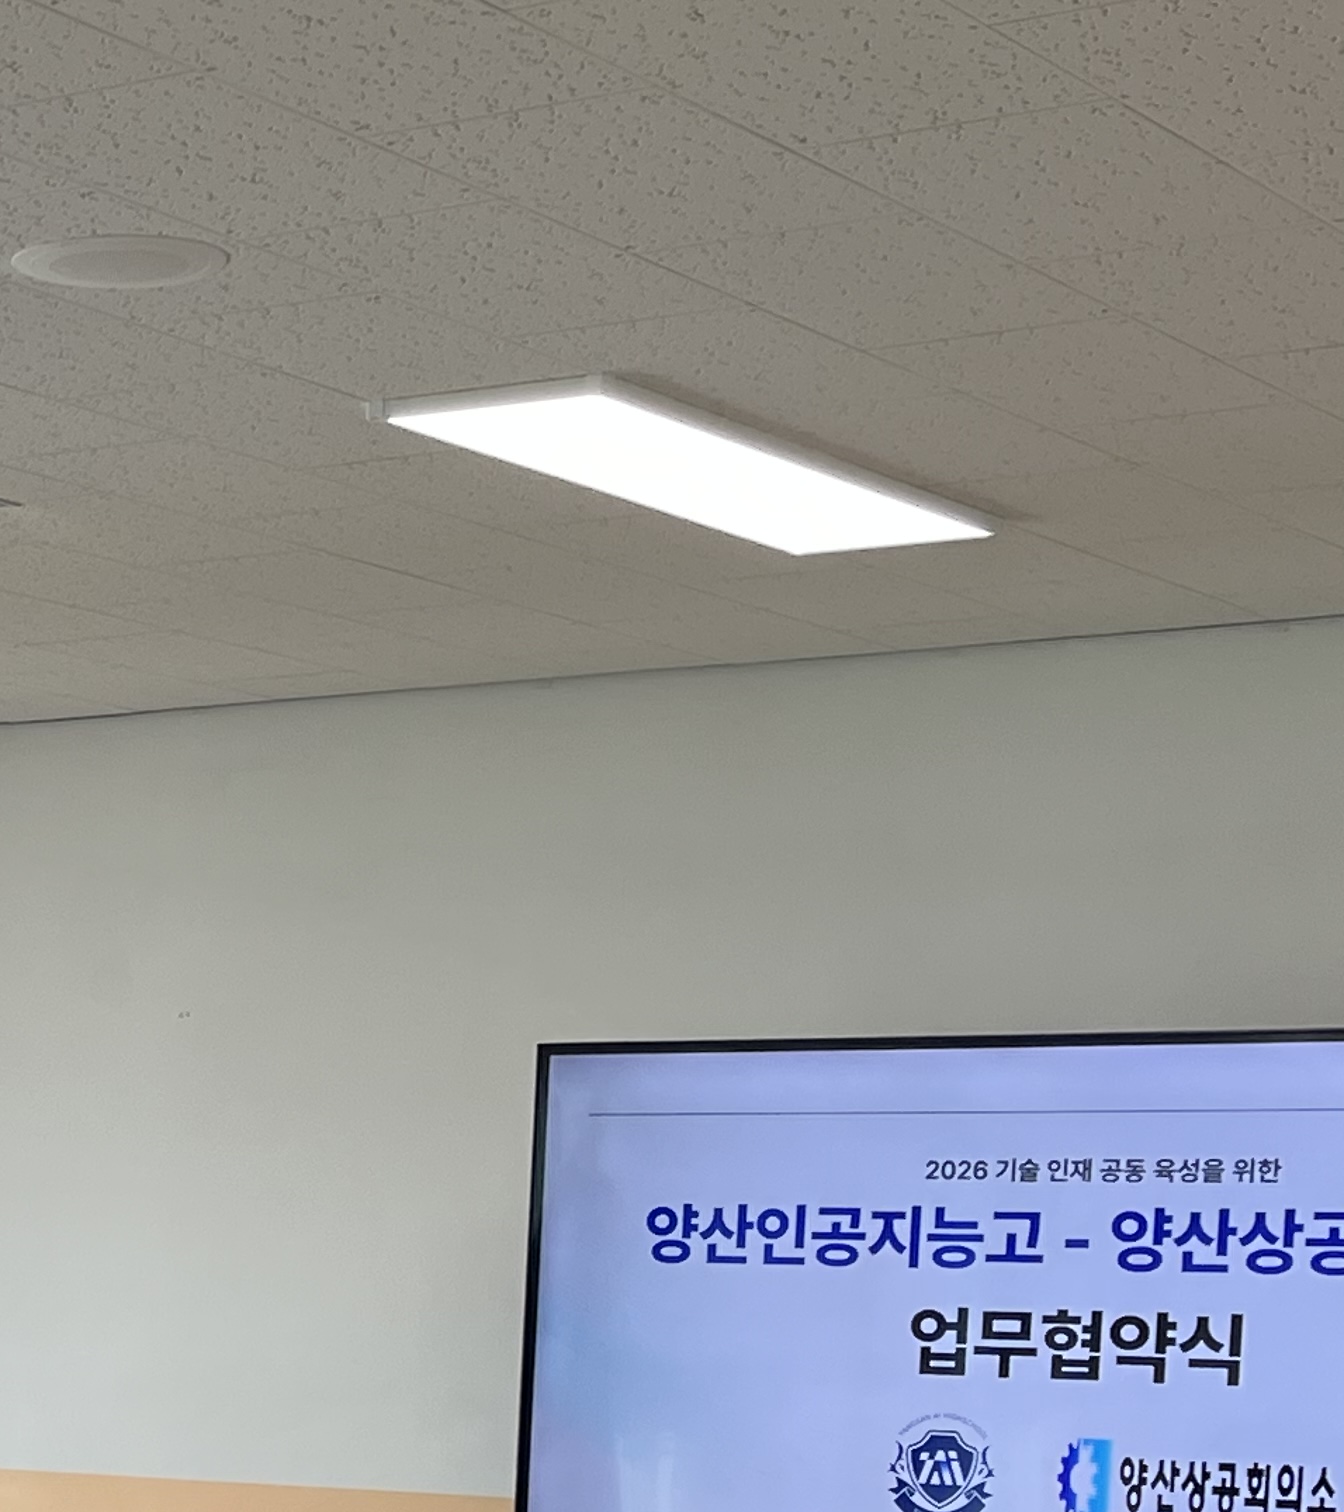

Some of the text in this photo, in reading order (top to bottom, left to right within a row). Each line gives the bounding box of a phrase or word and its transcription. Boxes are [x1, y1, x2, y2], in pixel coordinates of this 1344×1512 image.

[925, 1158, 1283, 1185] 2026 기술 인재 공동 육성을 위한
[644, 1203, 1044, 1269] 양산인공지능고
[911, 1306, 1244, 1387] 업무협약식
